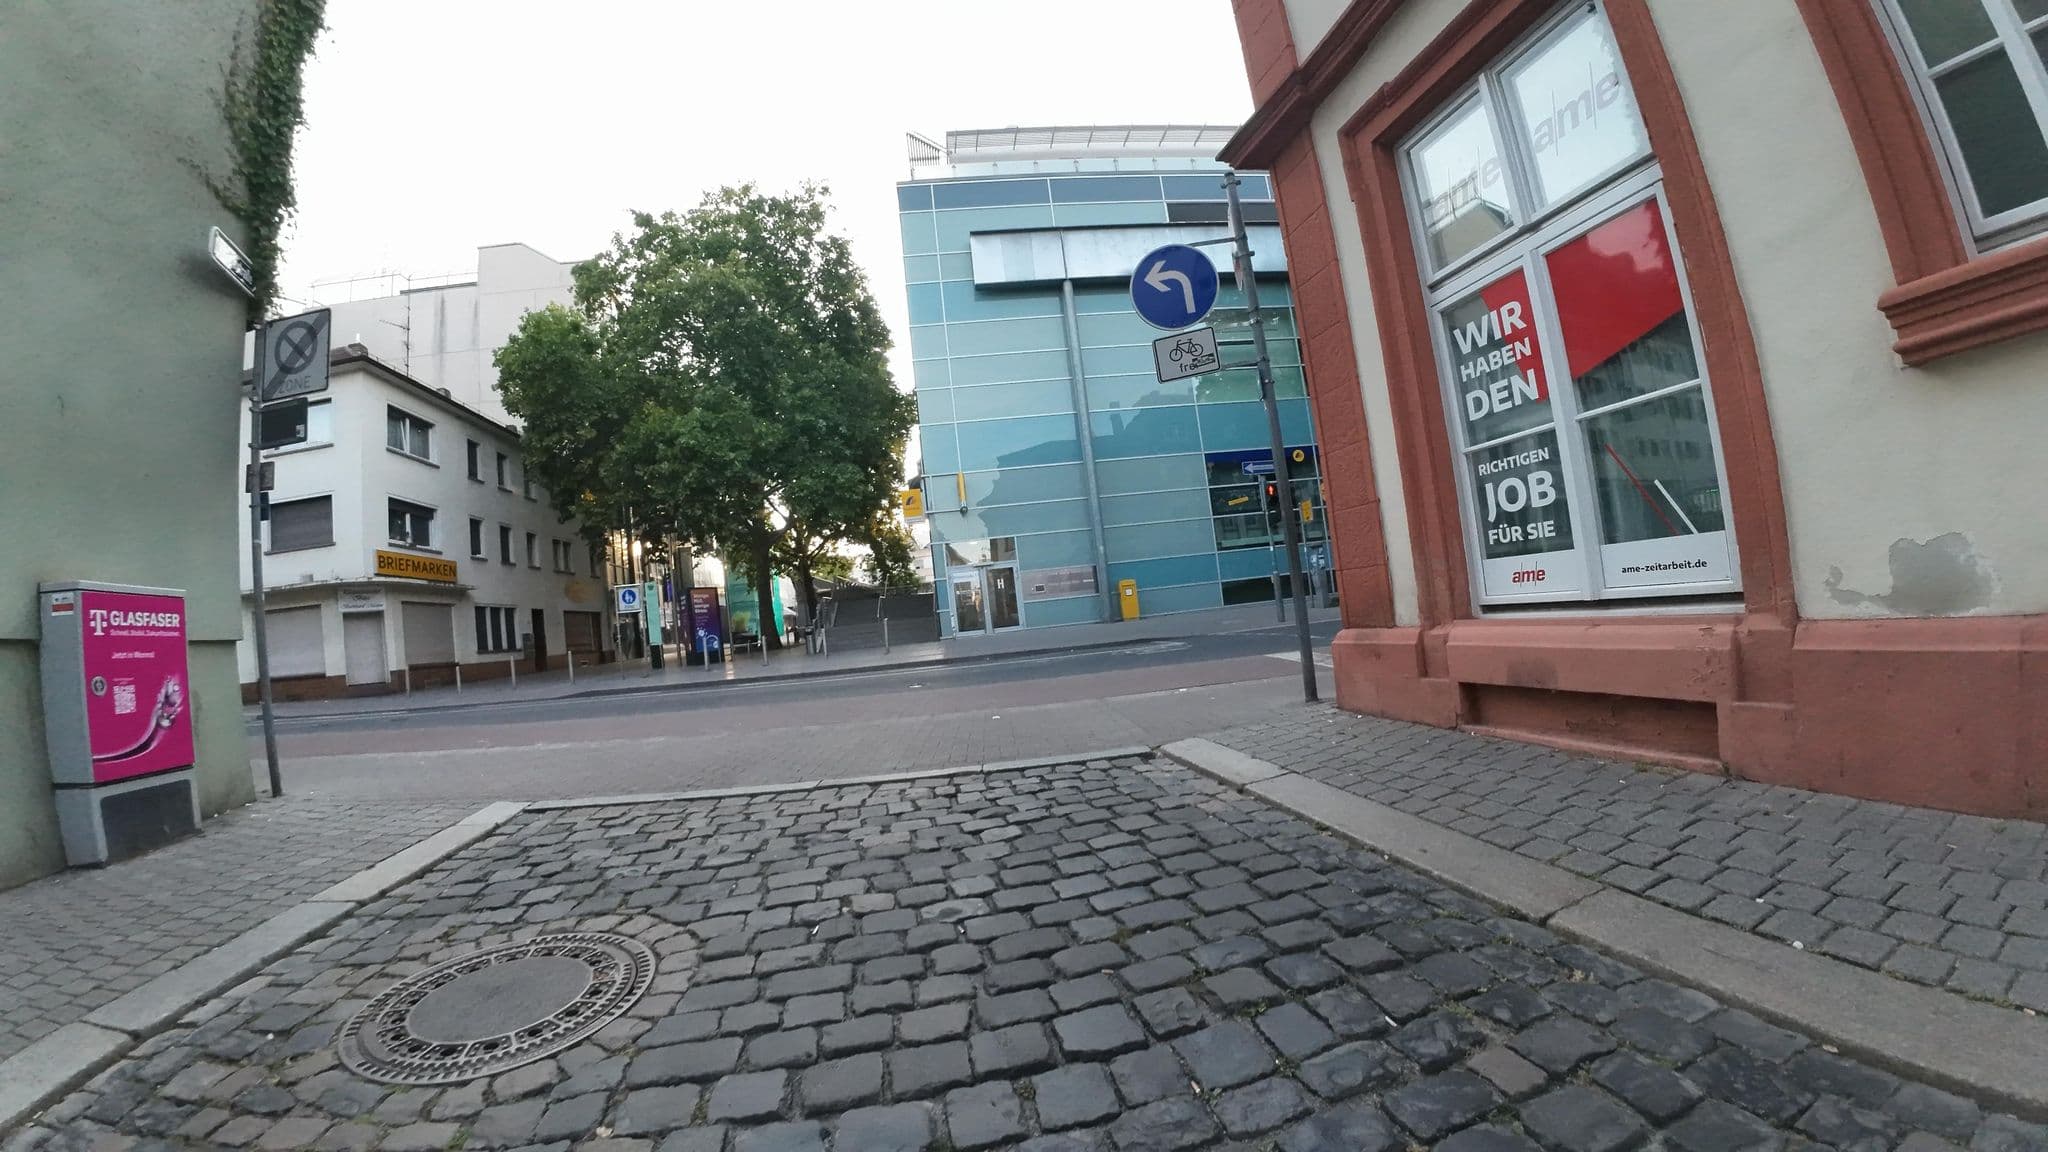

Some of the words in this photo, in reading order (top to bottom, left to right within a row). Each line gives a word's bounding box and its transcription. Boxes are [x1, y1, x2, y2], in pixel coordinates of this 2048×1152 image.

[1453, 299, 1528, 355] WIR
[1459, 337, 1532, 382] HABEN
[1466, 369, 1539, 422] DEN
[1478, 446, 1550, 477] RICHTIGEN
[1484, 470, 1556, 522] JOB
[1488, 522, 1524, 545] FÜR
[1527, 519, 1556, 540] SIE
[378, 555, 457, 578] BRIEFMARKEN
[1512, 568, 1546, 584] ame
[1621, 558, 1709, 574] ame-zeitarbeit.de
[110, 610, 180, 628] GLASFASER
